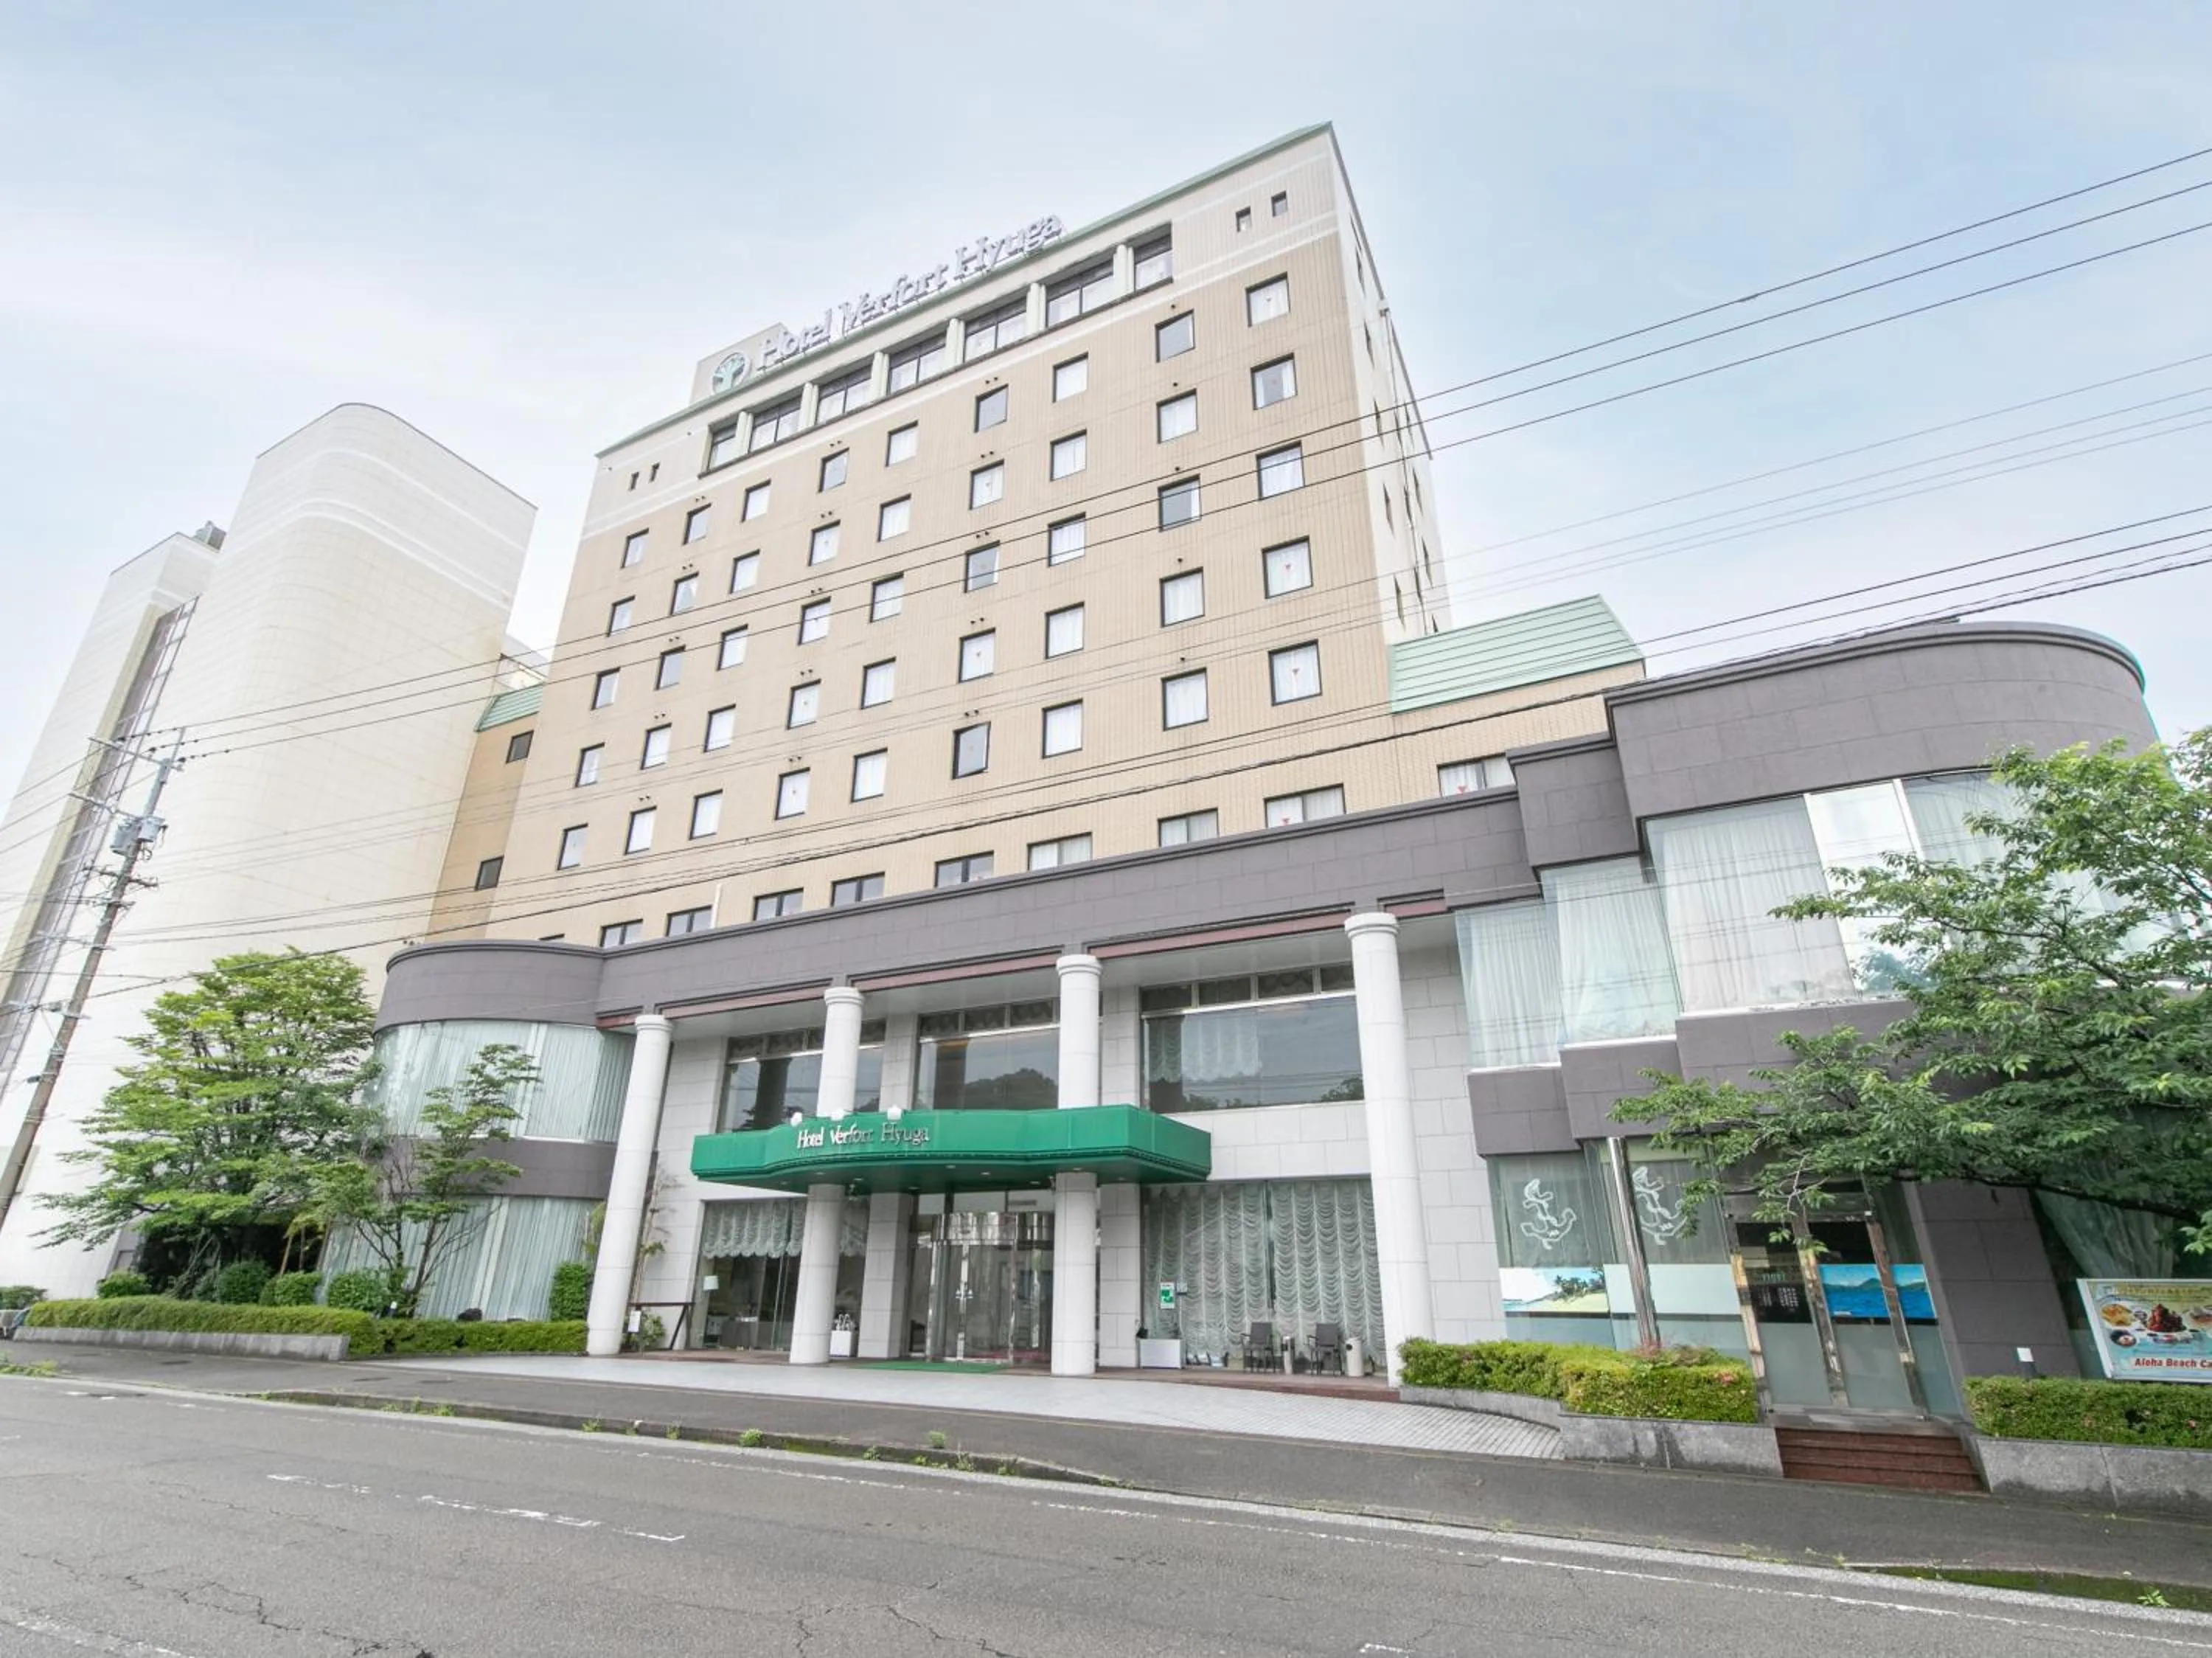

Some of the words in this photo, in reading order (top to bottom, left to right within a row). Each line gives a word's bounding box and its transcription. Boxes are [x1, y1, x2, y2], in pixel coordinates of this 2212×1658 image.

[757, 308, 832, 371] Hotel
[838, 263, 949, 335] Verfort
[953, 214, 1062, 280] Hyuga
[797, 1125, 824, 1148] Hotel
[881, 1121, 931, 1145] Hyuga
[2135, 1358, 2163, 1367] Aloha
[2166, 1358, 2197, 1368] Beach
